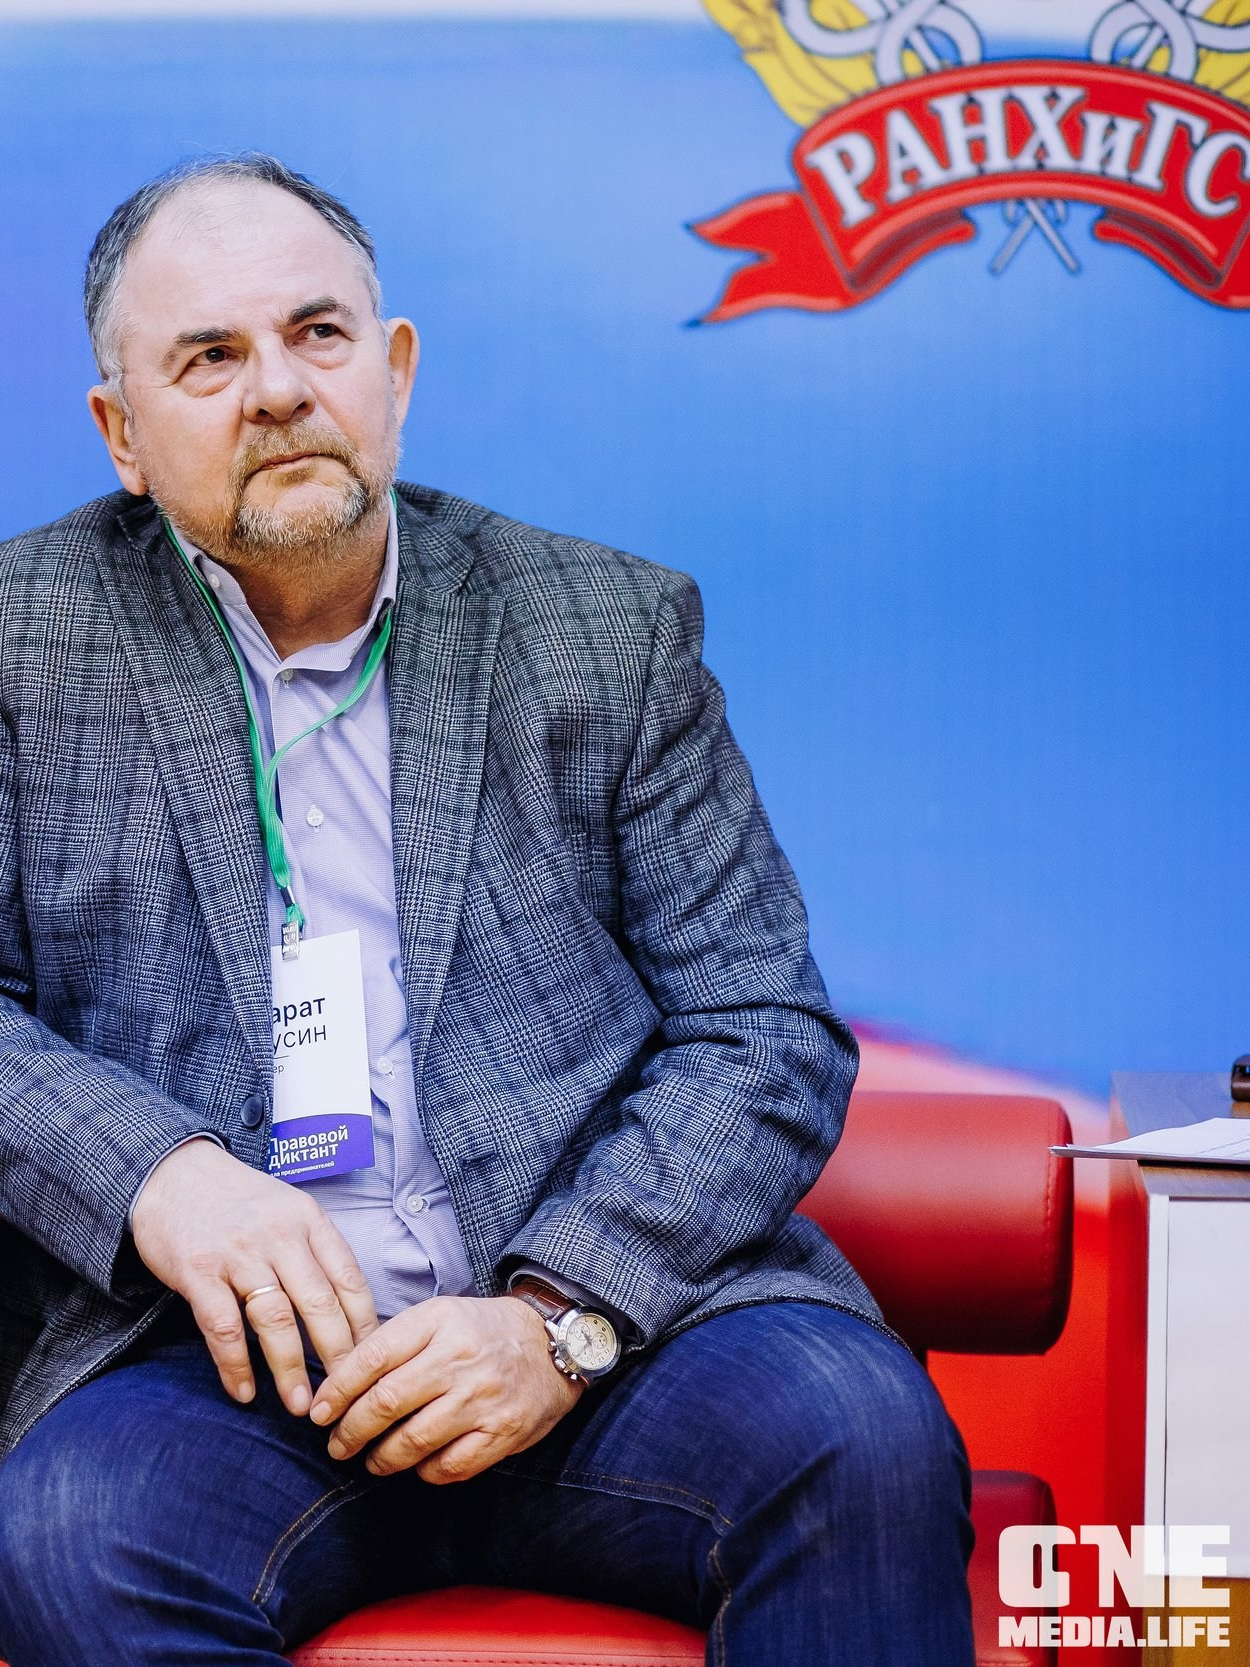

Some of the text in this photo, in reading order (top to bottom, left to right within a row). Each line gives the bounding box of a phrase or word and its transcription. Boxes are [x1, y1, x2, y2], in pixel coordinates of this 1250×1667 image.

[804, 85, 1250, 228] РАНХиГС
[272, 997, 326, 1027] арат
[273, 1024, 327, 1056] усин
